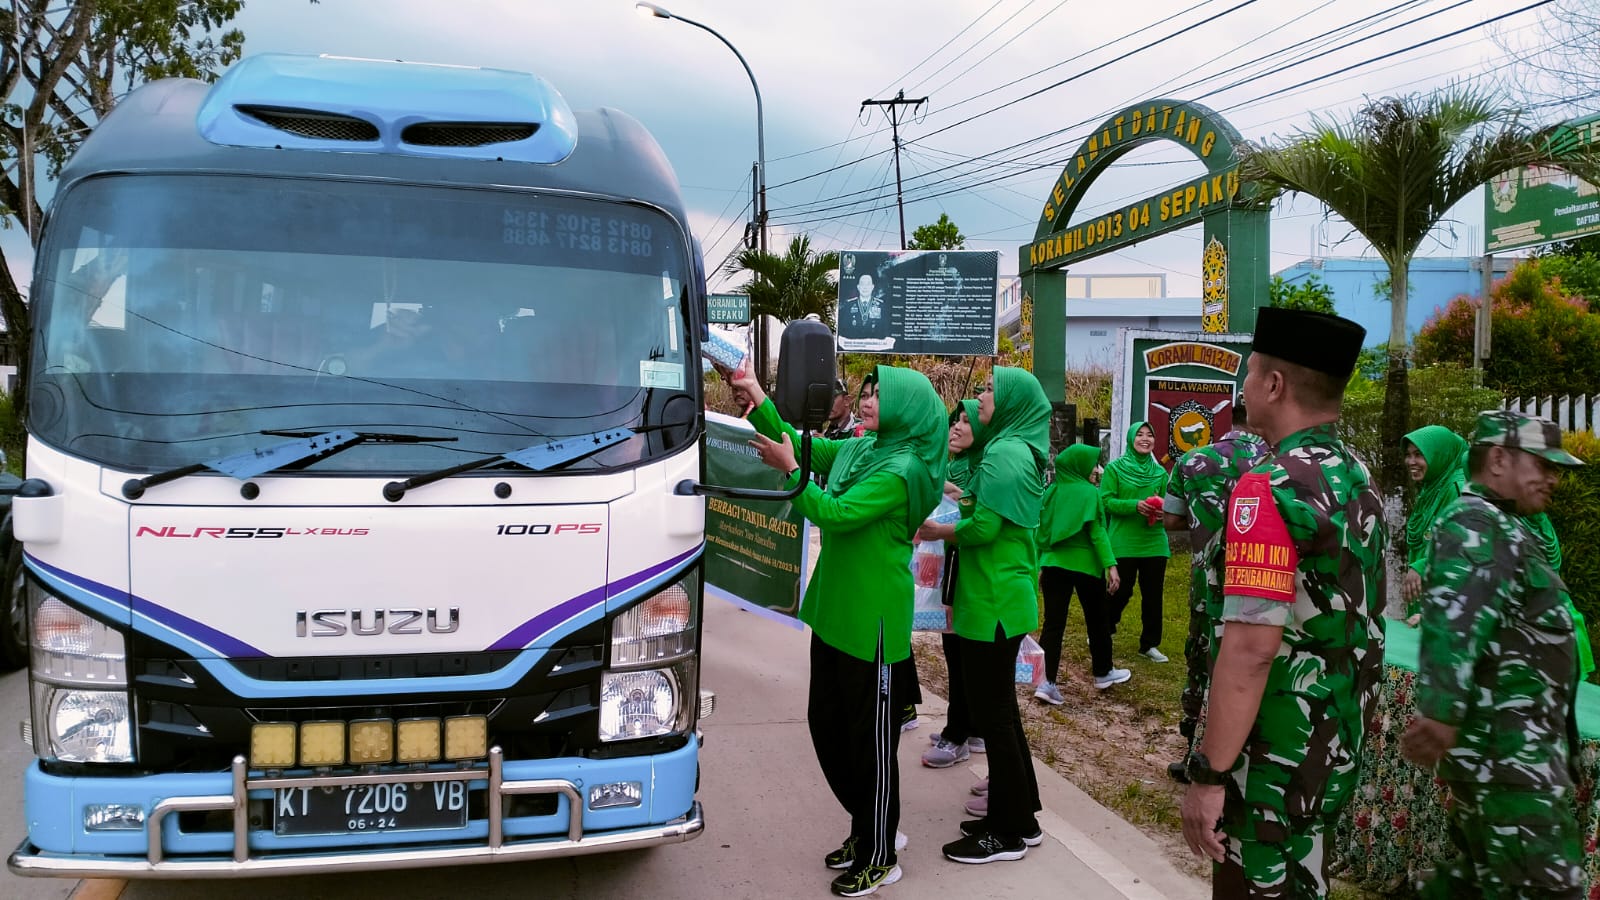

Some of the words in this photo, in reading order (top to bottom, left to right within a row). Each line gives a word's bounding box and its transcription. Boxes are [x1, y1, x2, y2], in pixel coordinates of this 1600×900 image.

[1044, 115, 1125, 222] SELAMAT
[1131, 105, 1217, 157] DATANG
[1030, 228, 1085, 266] KORAMIL
[1086, 213, 1123, 247] 0913
[1129, 203, 1150, 231] 04
[1160, 169, 1240, 222] SEPAKU
[707, 298, 737, 308] KORAMIL
[738, 298, 747, 308] 04
[711, 310, 744, 320] SEPAKU
[1146, 345, 1200, 370] KORAMIL
[1158, 381, 1230, 393] MULAWARMAN
[708, 497, 740, 519] BERBAGI
[741, 508, 768, 529] TAKJIL
[768, 517, 798, 538] GRATIS
[1240, 542, 1265, 564] PAM
[1269, 545, 1290, 567] IKN
[1236, 568, 1293, 593] PENGAMANAN
[296, 606, 460, 638] ISUZU
[279, 787, 312, 818] KT
[341, 783, 408, 815] 7206
[433, 780, 464, 811] VB
